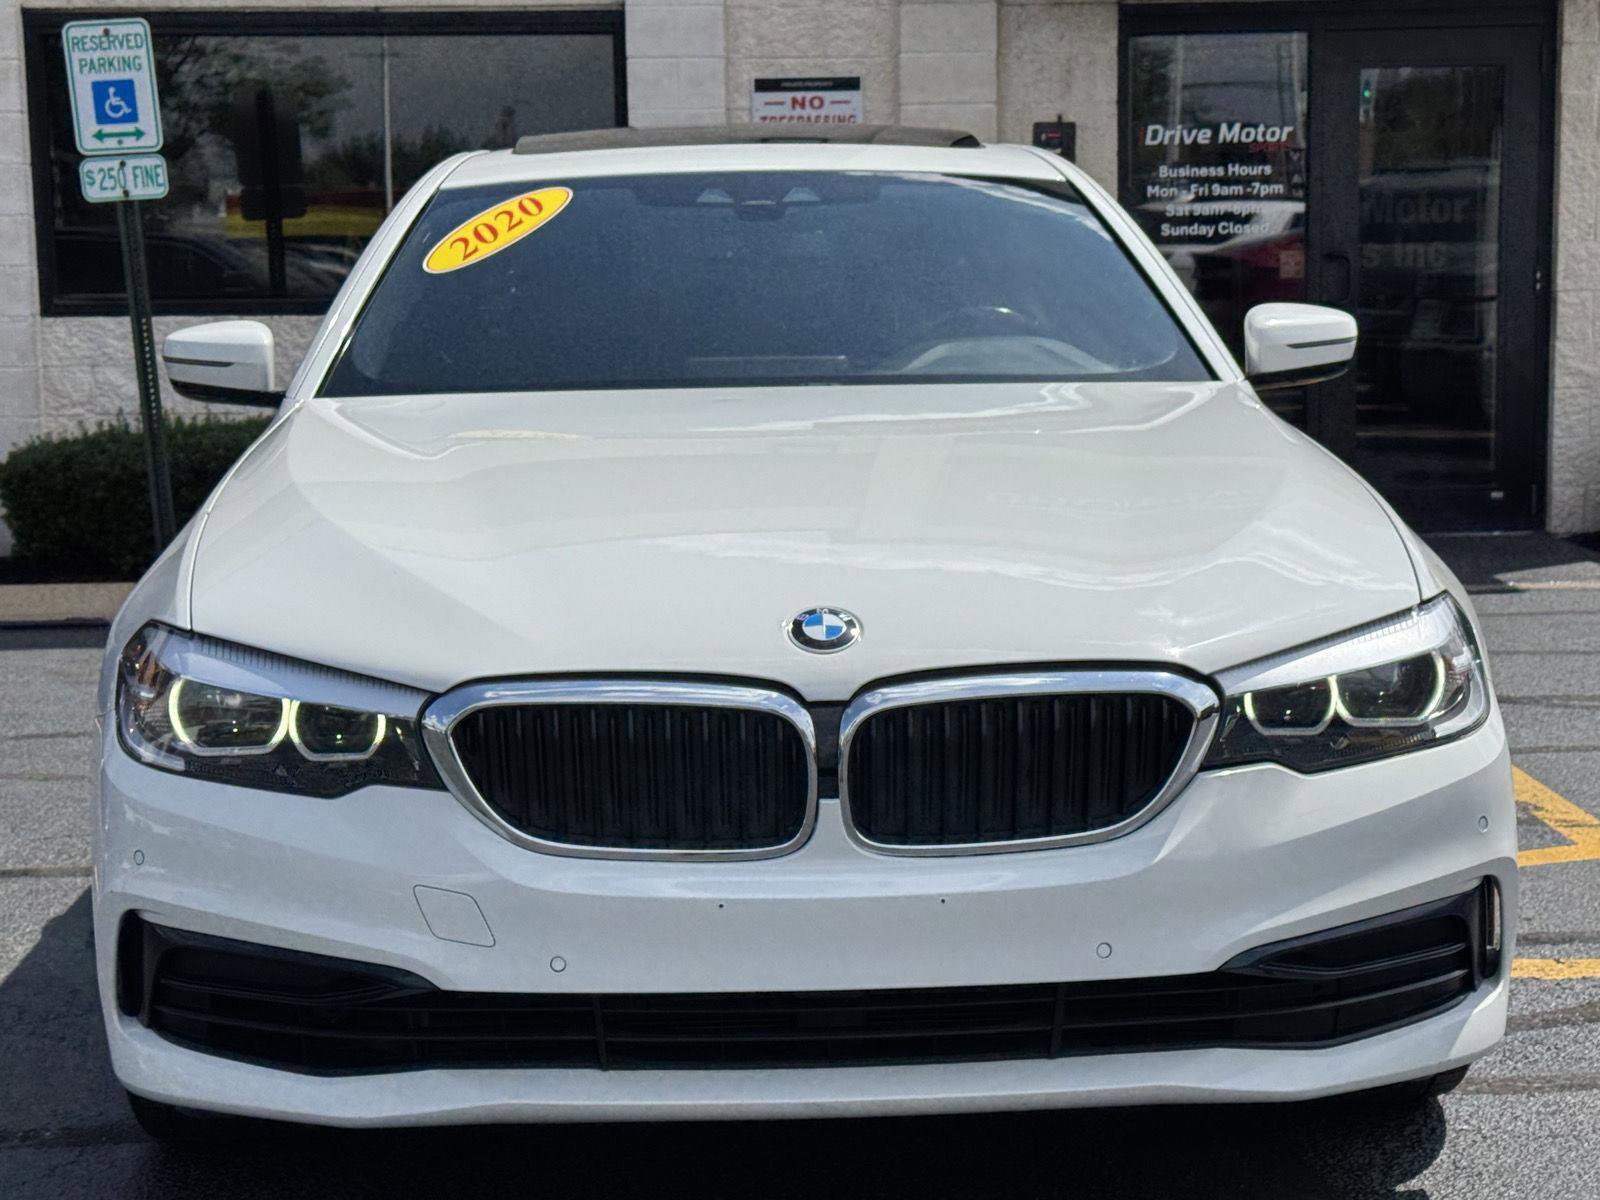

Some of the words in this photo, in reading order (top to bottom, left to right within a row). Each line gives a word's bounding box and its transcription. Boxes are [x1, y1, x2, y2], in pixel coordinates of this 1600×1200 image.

[71, 32, 144, 52] RESERVED
[79, 56, 142, 74] PARKING
[790, 95, 824, 110] NO
[1218, 122, 1295, 144] Motor
[85, 166, 127, 191] $250
[132, 164, 165, 188] FINE
[1159, 164, 1225, 178] Business
[1227, 163, 1273, 176] Hours
[1147, 185, 1178, 198] Mon
[1190, 184, 1208, 197] Fri
[1211, 184, 1243, 196] 9am
[449, 197, 544, 261] 2020
[1160, 223, 1215, 238] Sunday
[1218, 222, 1270, 236] Closed
